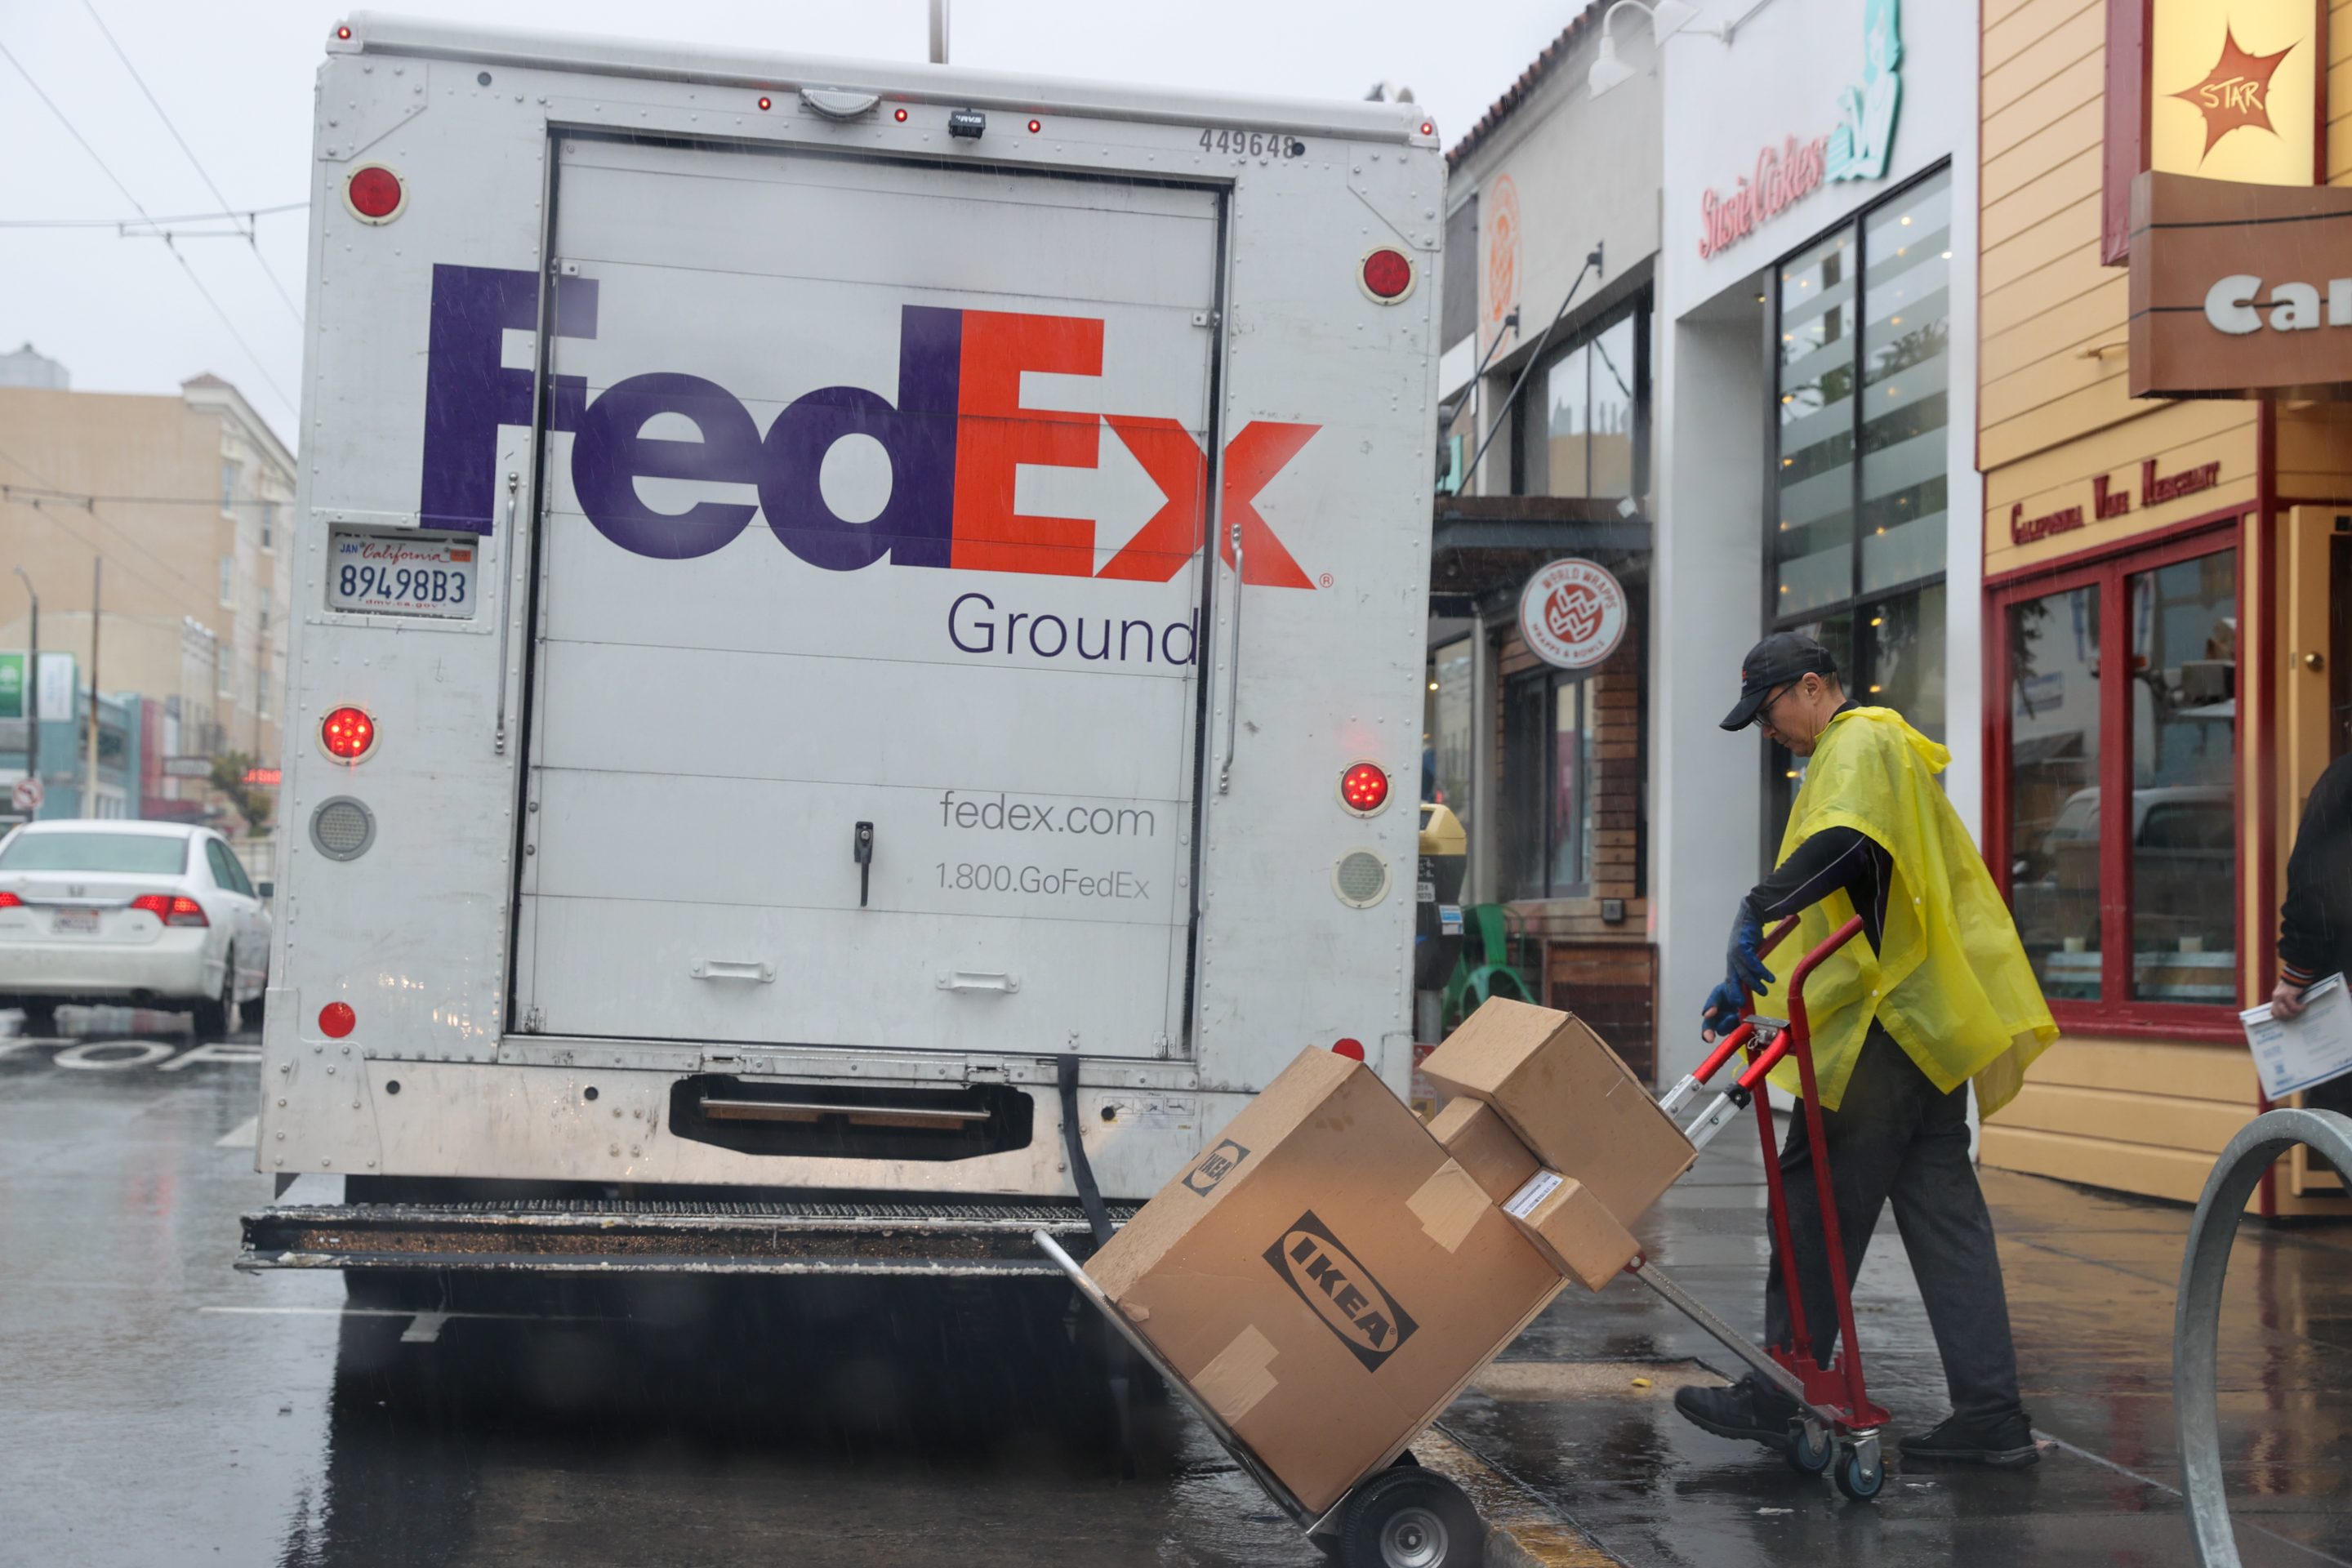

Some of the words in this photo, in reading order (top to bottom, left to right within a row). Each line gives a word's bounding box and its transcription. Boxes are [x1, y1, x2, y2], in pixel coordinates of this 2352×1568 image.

[2200, 76, 2264, 114] STAR
[1199, 129, 1296, 158] 449648
[420, 263, 1324, 590] FedEx
[341, 543, 358, 555] JAN
[362, 542, 450, 565] California
[340, 564, 466, 604] 89498B3
[366, 598, 439, 609] dmv.ca.gov
[947, 592, 1200, 666] Ground
[939, 790, 1155, 837] fedex.com
[936, 862, 1150, 900] 1.800.GoFedEx
[1198, 1152, 1232, 1181] IKEA
[1290, 1236, 1390, 1349] IKEA
